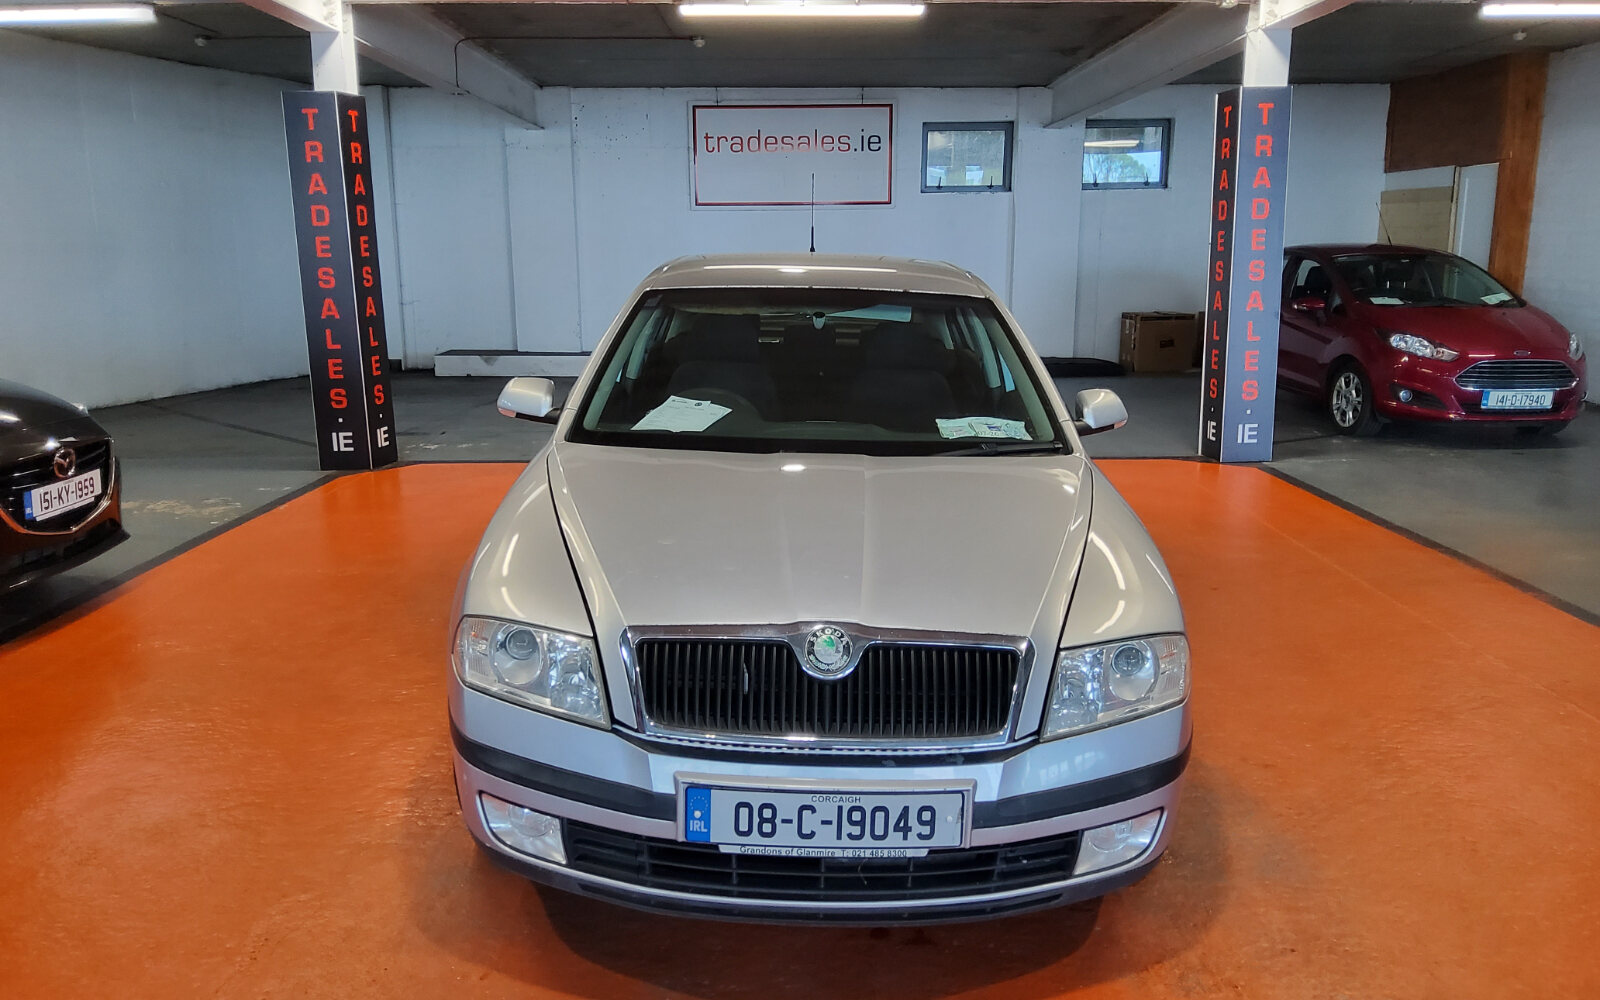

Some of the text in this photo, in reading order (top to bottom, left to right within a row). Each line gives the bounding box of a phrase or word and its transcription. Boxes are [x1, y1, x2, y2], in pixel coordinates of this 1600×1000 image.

[703, 128, 882, 154] tradesales.ie
[39, 476, 95, 512] 151-KY-1959
[810, 795, 862, 804] CORCAIGH
[689, 820, 708, 832] IRL
[733, 801, 936, 841] 08-C-19049
[739, 846, 783, 856] Grandons
[785, 847, 794, 855] of
[796, 848, 836, 857] Glanmire
[851, 849, 866, 858] 021
[869, 849, 885, 858] 485
